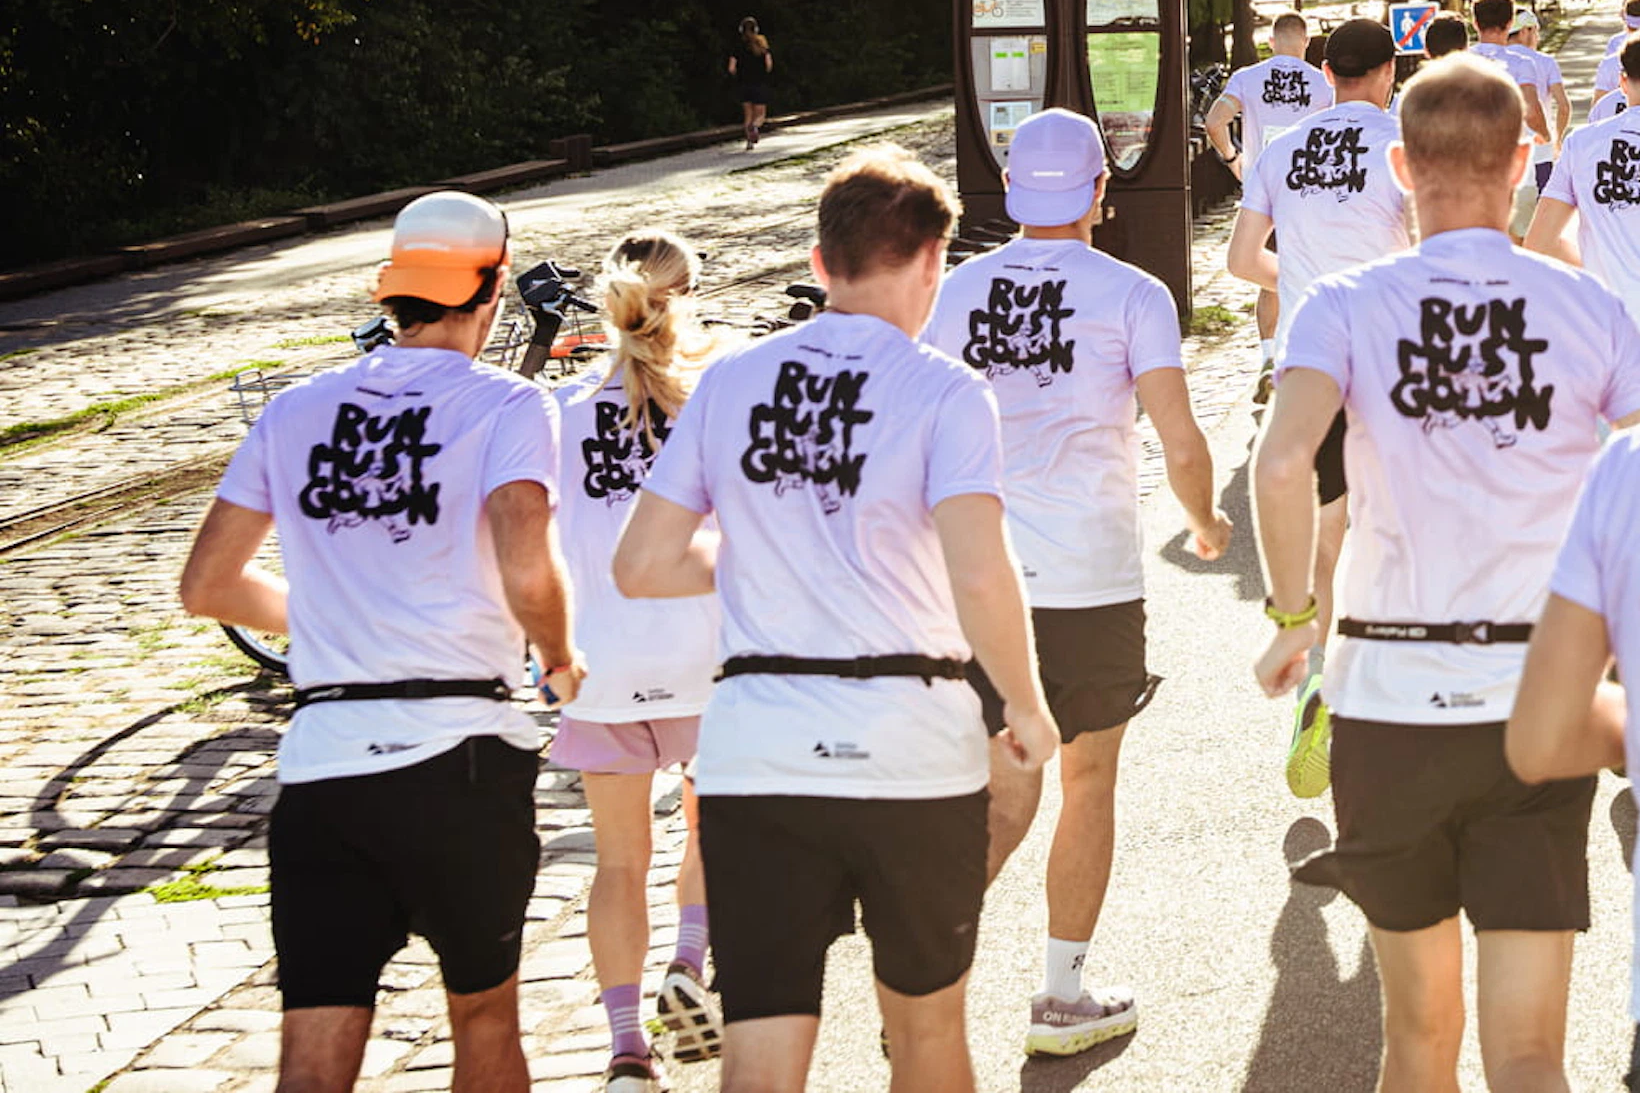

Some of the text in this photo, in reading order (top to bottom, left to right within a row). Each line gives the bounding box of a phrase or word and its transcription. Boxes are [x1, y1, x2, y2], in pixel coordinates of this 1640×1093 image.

[1264, 80, 1309, 95] MUST
[1271, 68, 1303, 82] RUN
[1292, 147, 1368, 169] MUST
[1306, 127, 1363, 152] RUN
[989, 278, 1067, 314] RUN
[970, 308, 1075, 342] MUST
[1420, 298, 1526, 347] RUN
[1397, 339, 1548, 387] MUST
[775, 362, 869, 407] RUN
[333, 403, 432, 450] RUN
[750, 403, 874, 452] MUST
[308, 443, 442, 485] MUST
